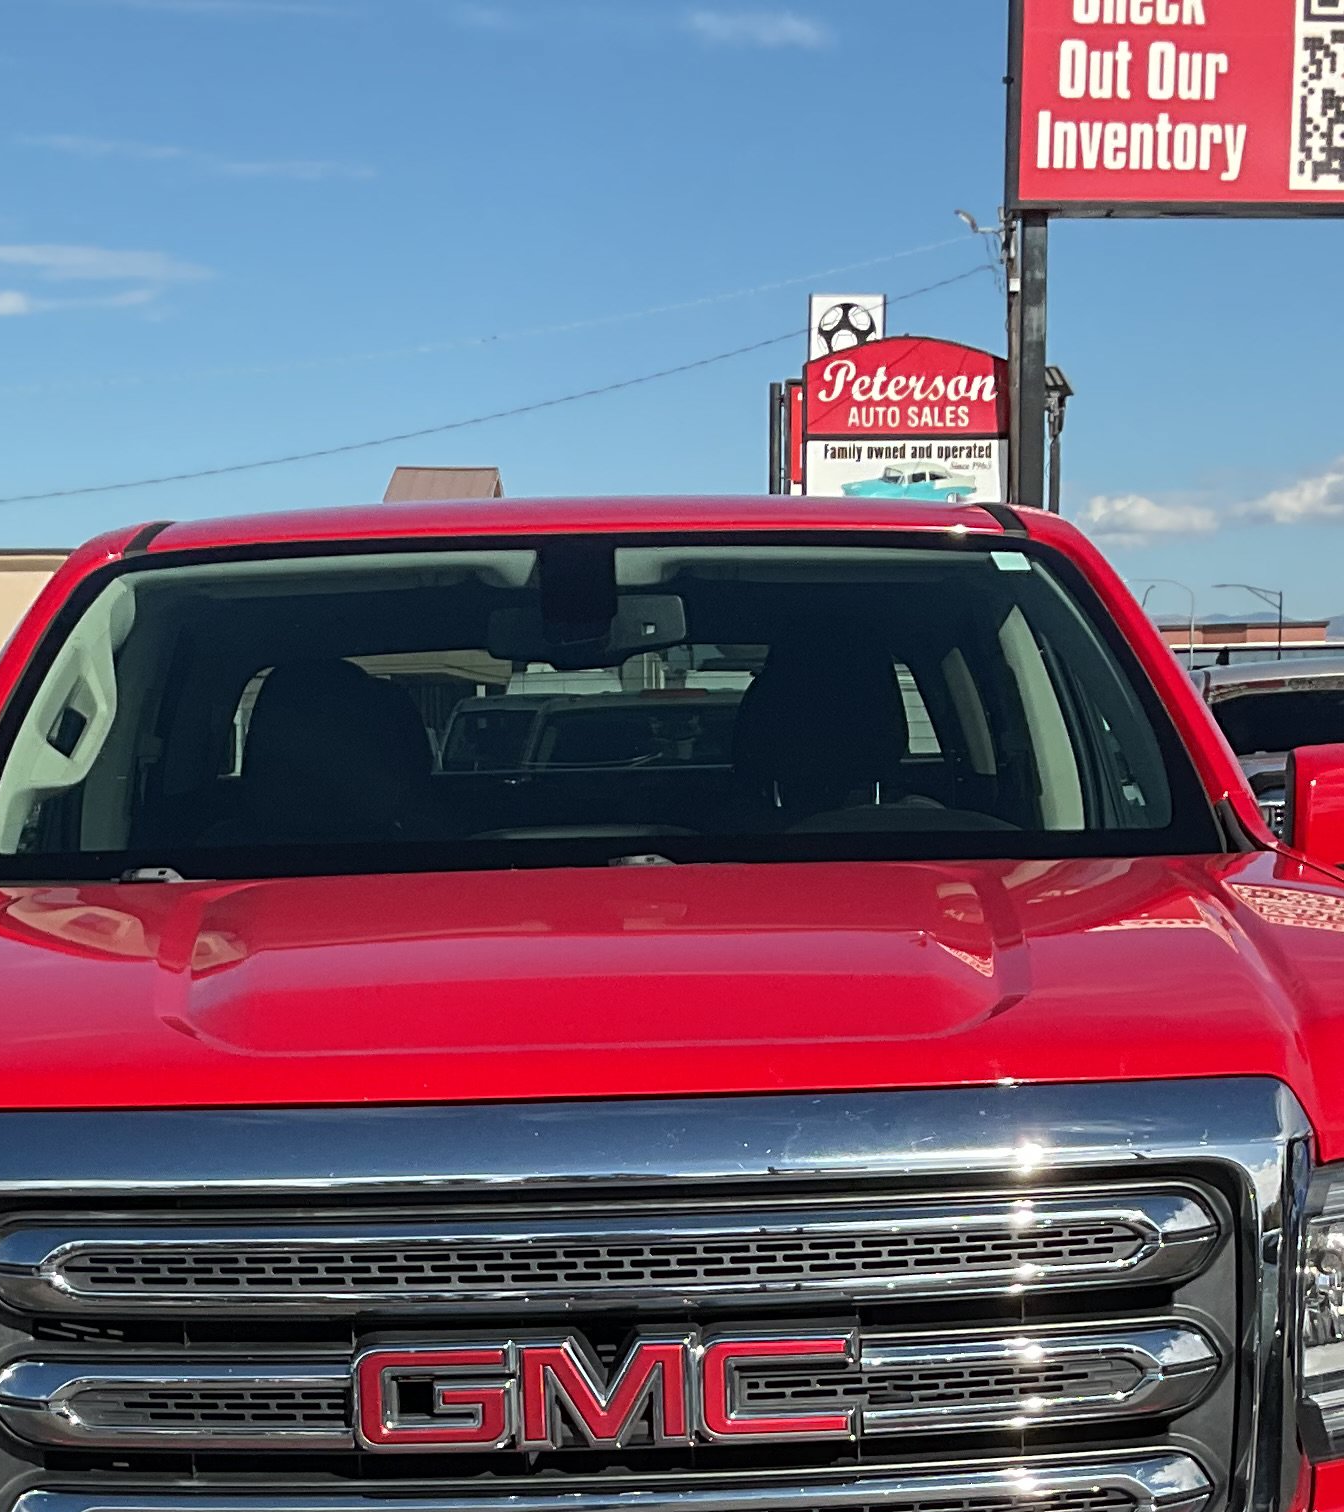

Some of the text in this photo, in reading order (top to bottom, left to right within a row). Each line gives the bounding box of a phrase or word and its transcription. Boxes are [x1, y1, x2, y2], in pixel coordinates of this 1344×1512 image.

[1059, 39, 1229, 100] Out Our
[1037, 110, 1247, 181] Inventory
[818, 359, 998, 402] Peterson
[848, 405, 969, 428] AUTO SALES
[824, 442, 992, 462] Family owned and operated
[354, 1329, 856, 1450] GMC
